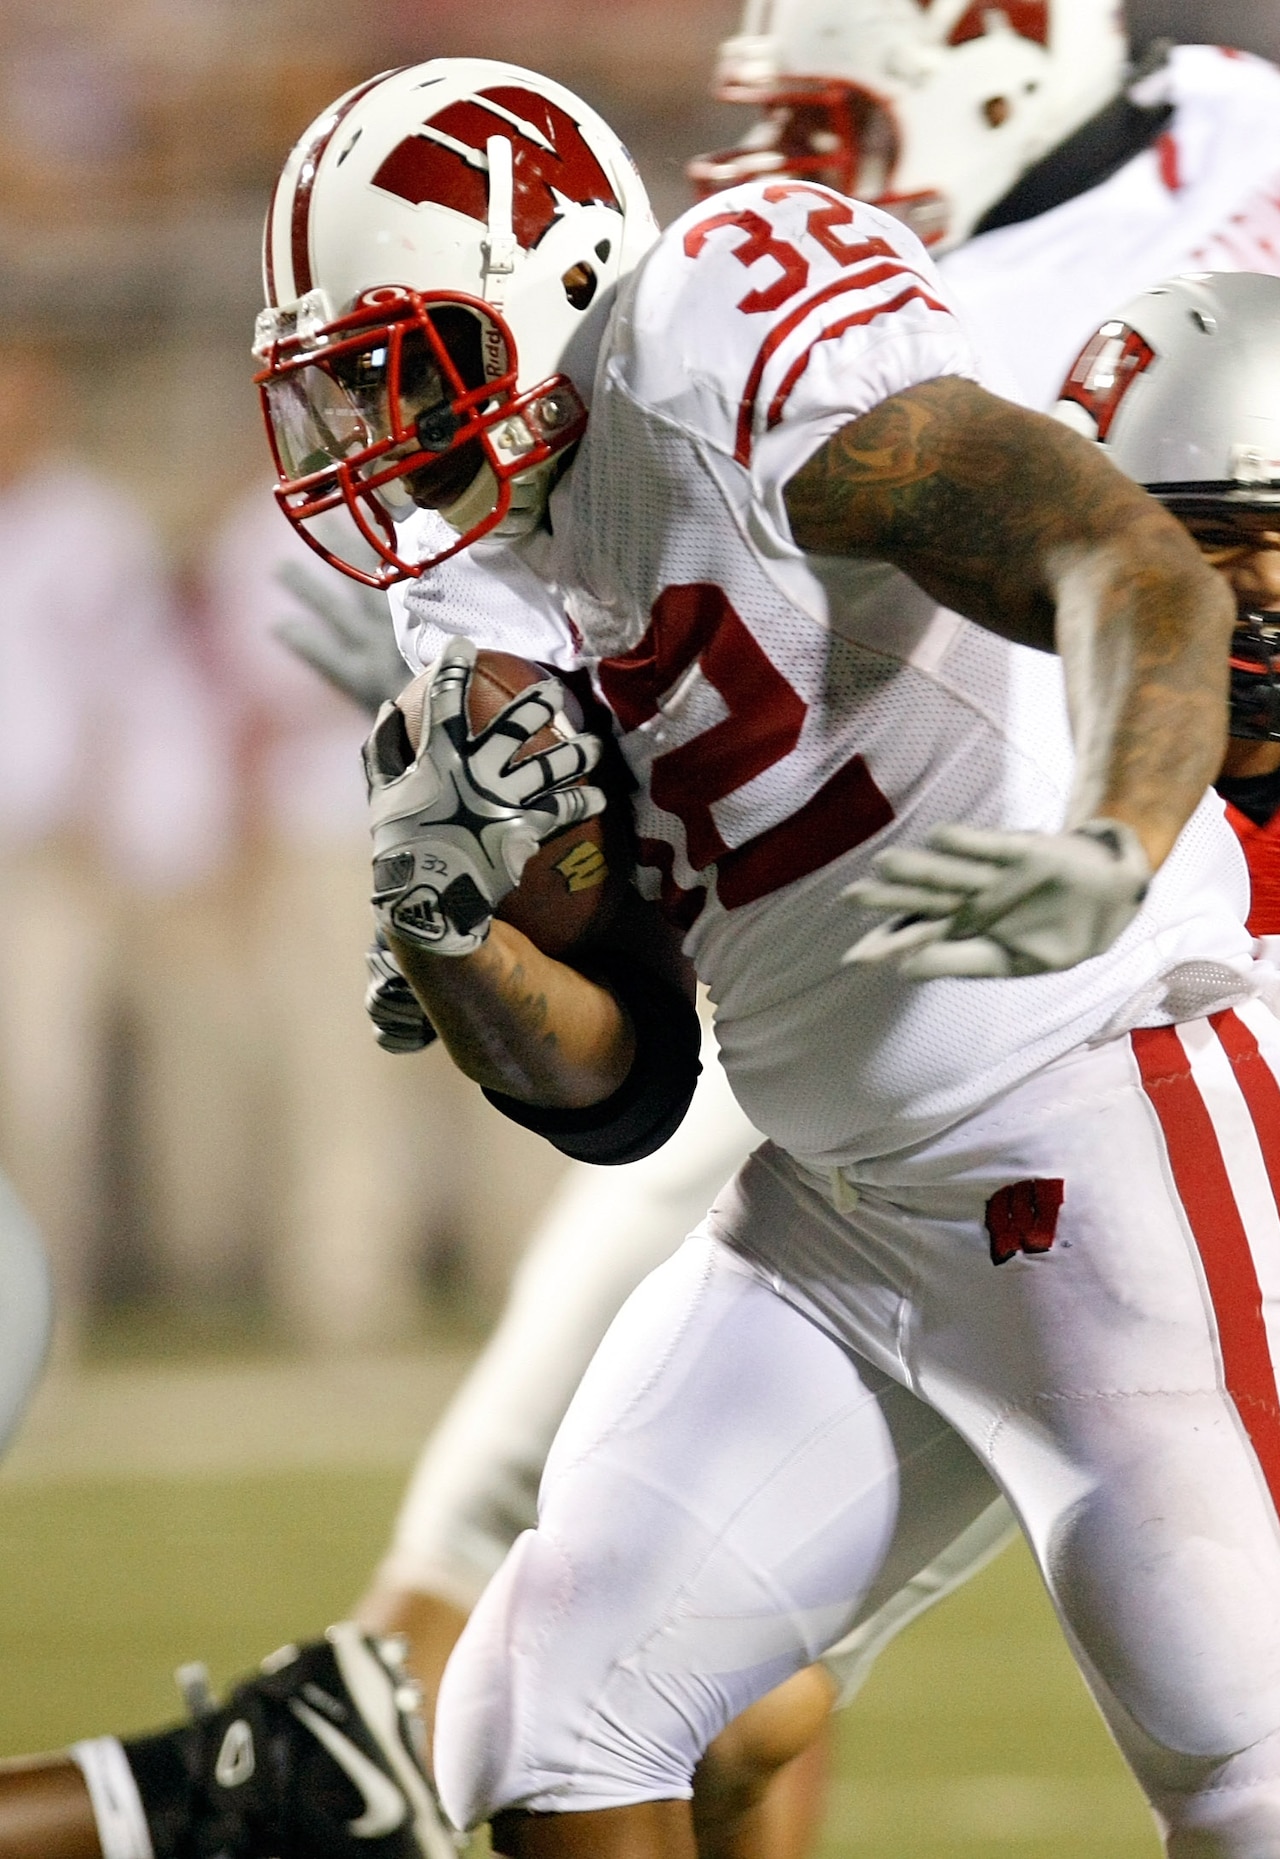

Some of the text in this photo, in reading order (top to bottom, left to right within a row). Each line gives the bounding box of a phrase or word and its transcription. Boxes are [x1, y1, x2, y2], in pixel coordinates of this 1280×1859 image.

[683, 184, 903, 315] 32
[421, 853, 449, 877] 32
[985, 1178, 1065, 1267] W
